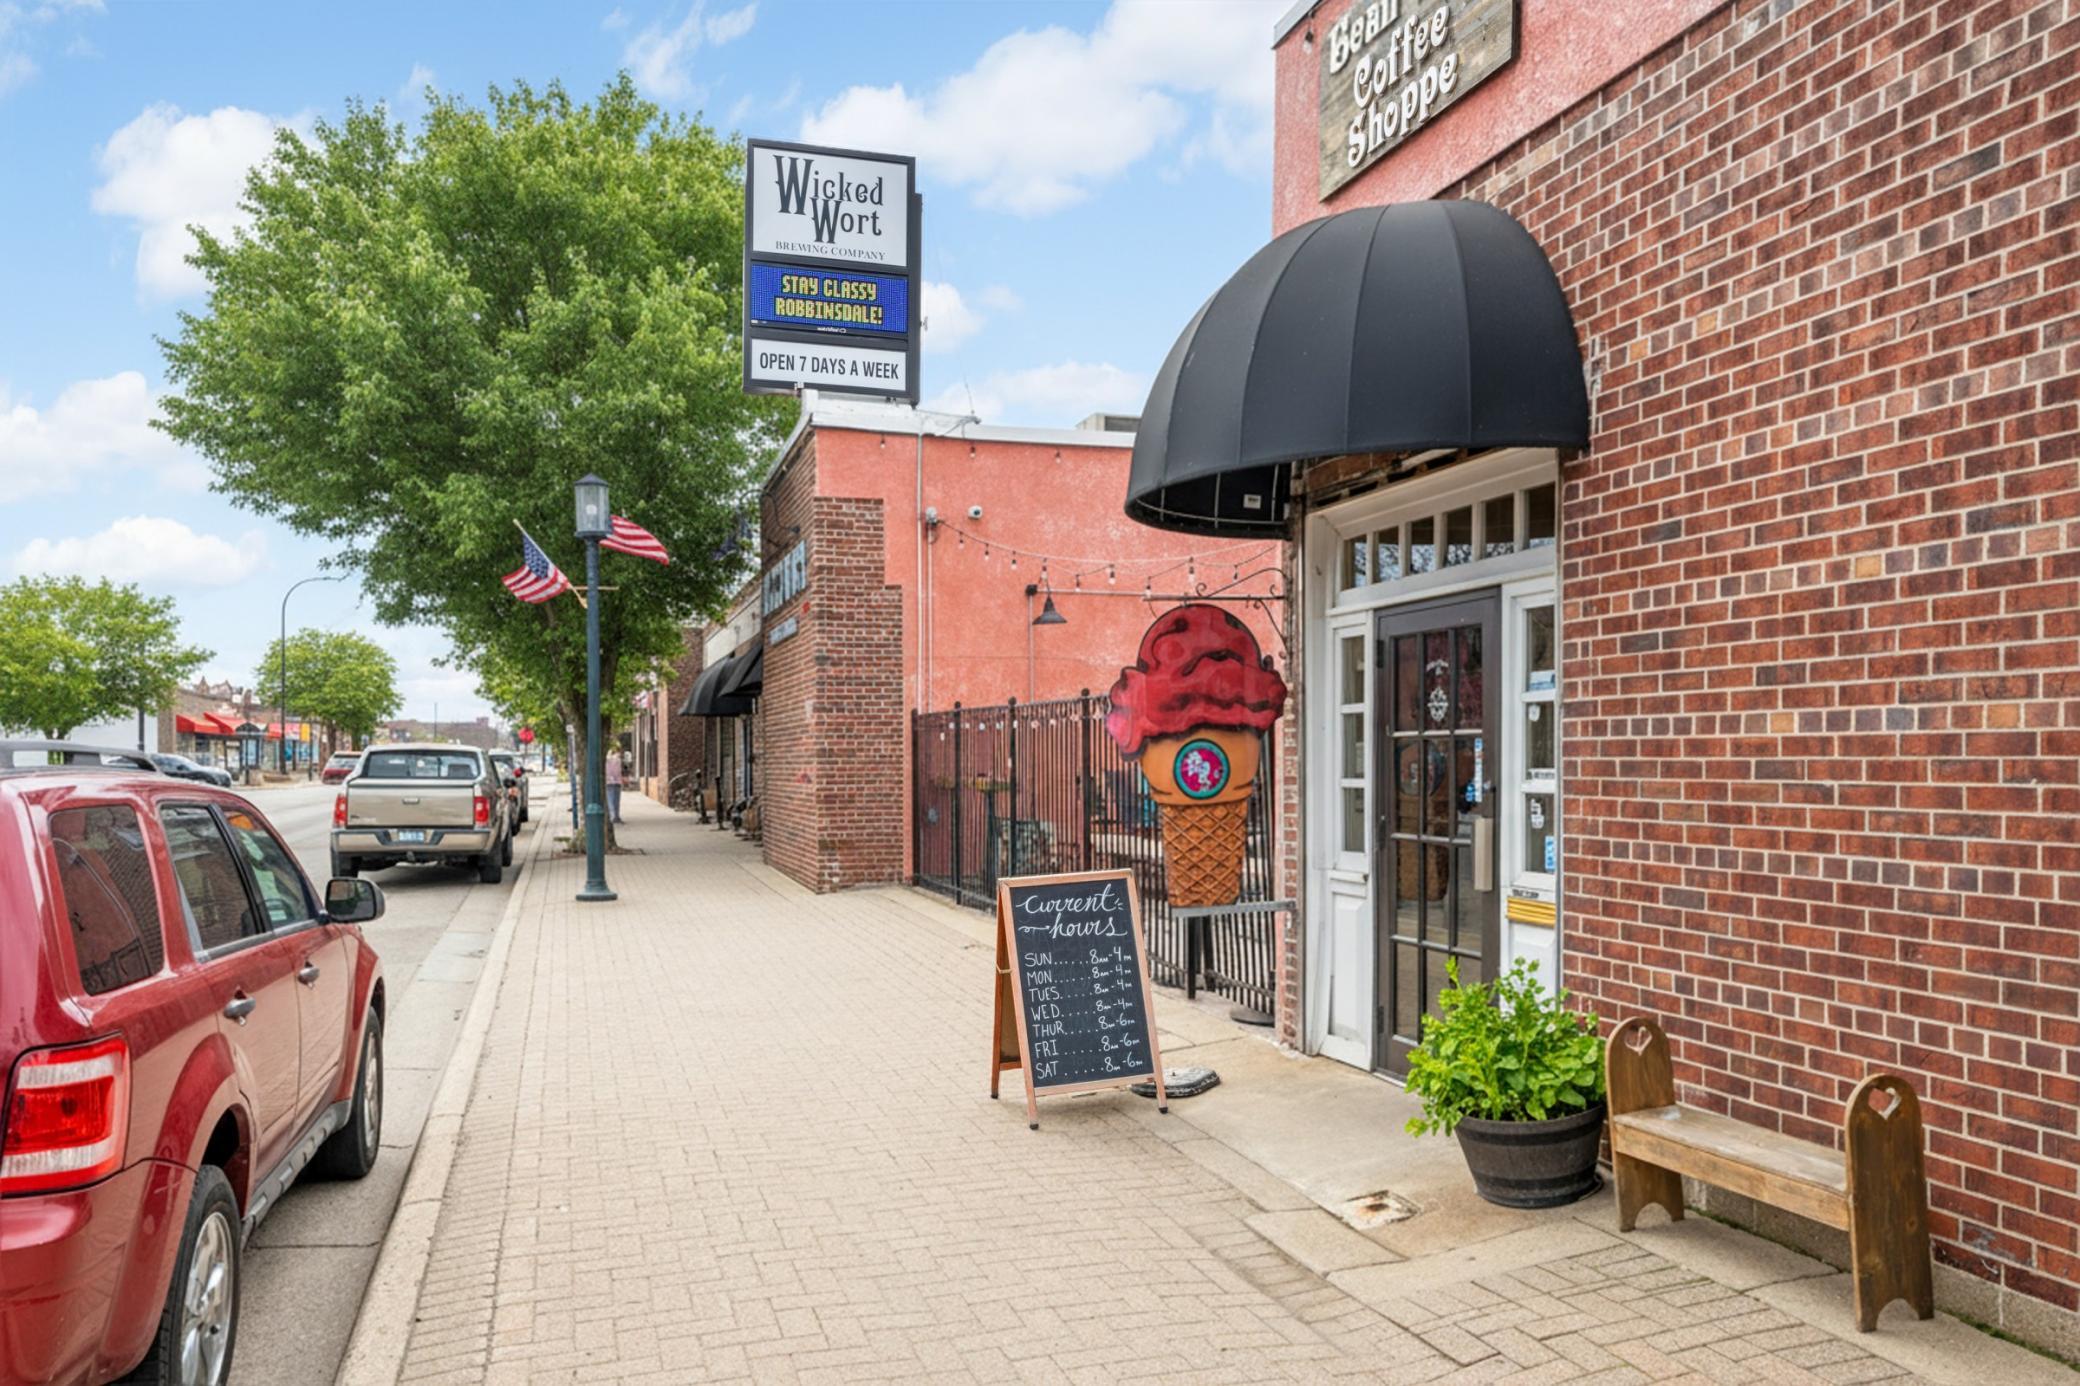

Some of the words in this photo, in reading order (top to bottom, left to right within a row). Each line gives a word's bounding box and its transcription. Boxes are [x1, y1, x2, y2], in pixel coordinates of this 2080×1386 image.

[1353, 6, 1450, 108] Coffee
[1348, 53, 1458, 168] Shoppe
[773, 154, 883, 215] Wicked
[810, 196, 882, 244] Wort
[775, 240, 829, 255] BREWING
[831, 246, 886, 261] COMPANY
[782, 274, 818, 296] STAY
[823, 279, 877, 301] CLASSY
[775, 297, 883, 325] ROBBINSDALE!
[759, 352, 795, 371] OPEN
[799, 355, 807, 372] 7
[811, 356, 846, 375] DAYS
[850, 360, 859, 376] A
[862, 361, 899, 379] WEEK
[1016, 883, 1117, 914] Current
[1049, 912, 1128, 939] hours
[1024, 952, 1052, 967] SUN
[1026, 970, 1052, 987] MON
[1028, 986, 1060, 1002] TUES
[1031, 1003, 1060, 1021] WED
[1032, 1020, 1065, 1038] THUR
[1034, 1039, 1060, 1059] FRI
[1036, 1060, 1059, 1079] SAT
